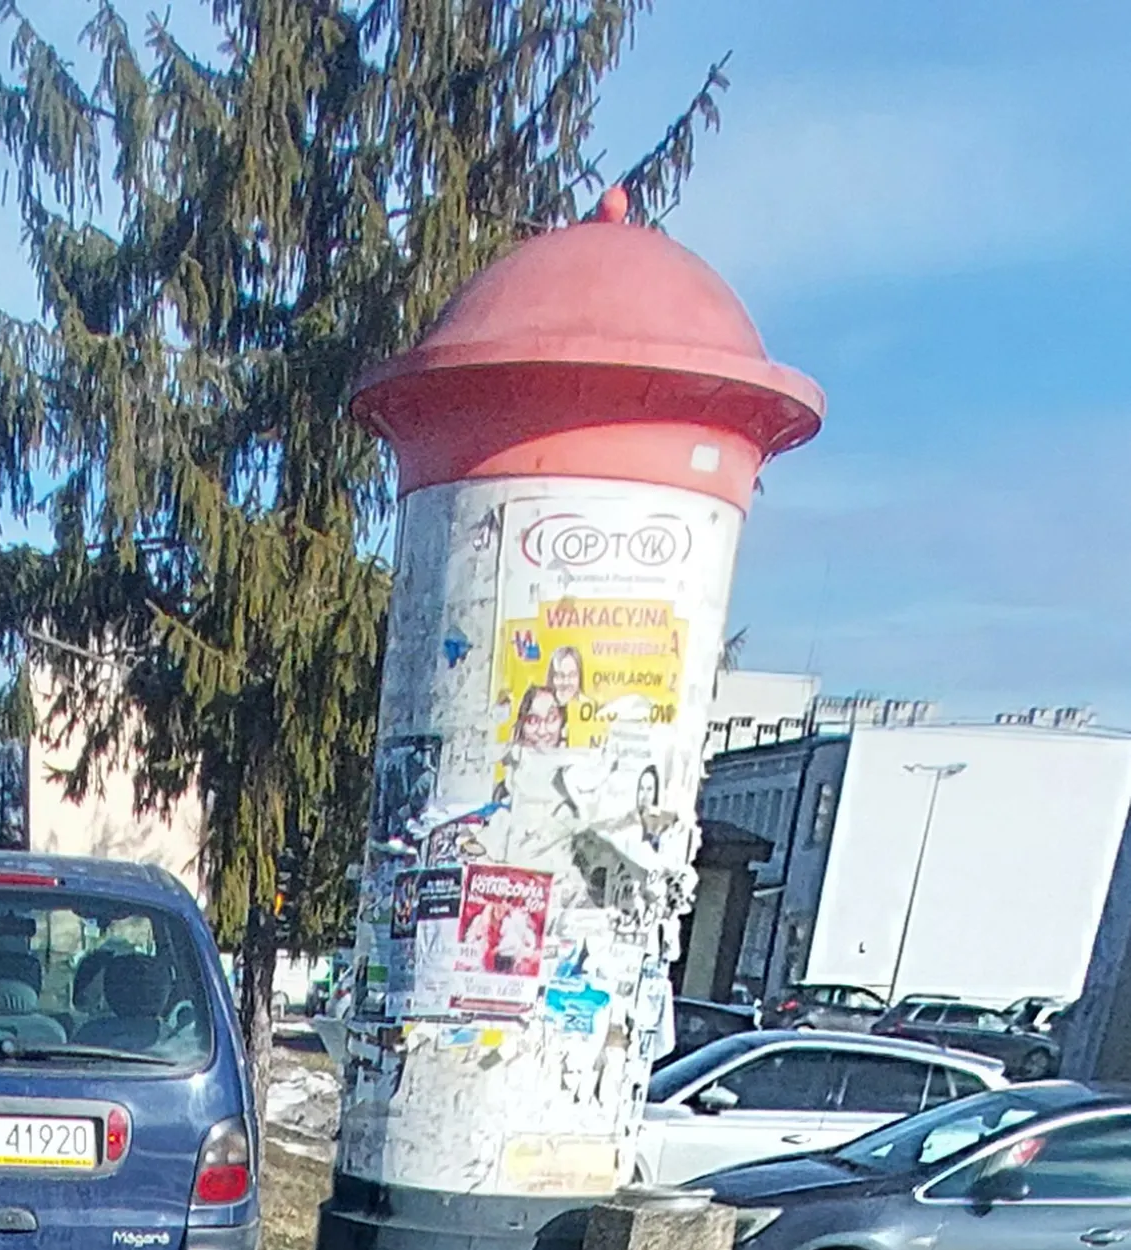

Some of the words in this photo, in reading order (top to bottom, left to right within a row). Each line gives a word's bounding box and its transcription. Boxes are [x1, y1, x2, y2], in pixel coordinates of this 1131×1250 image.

[560, 531, 670, 562] OPTYK
[546, 606, 670, 629] WAKACYJNA
[5, 1124, 87, 1156] 41920
